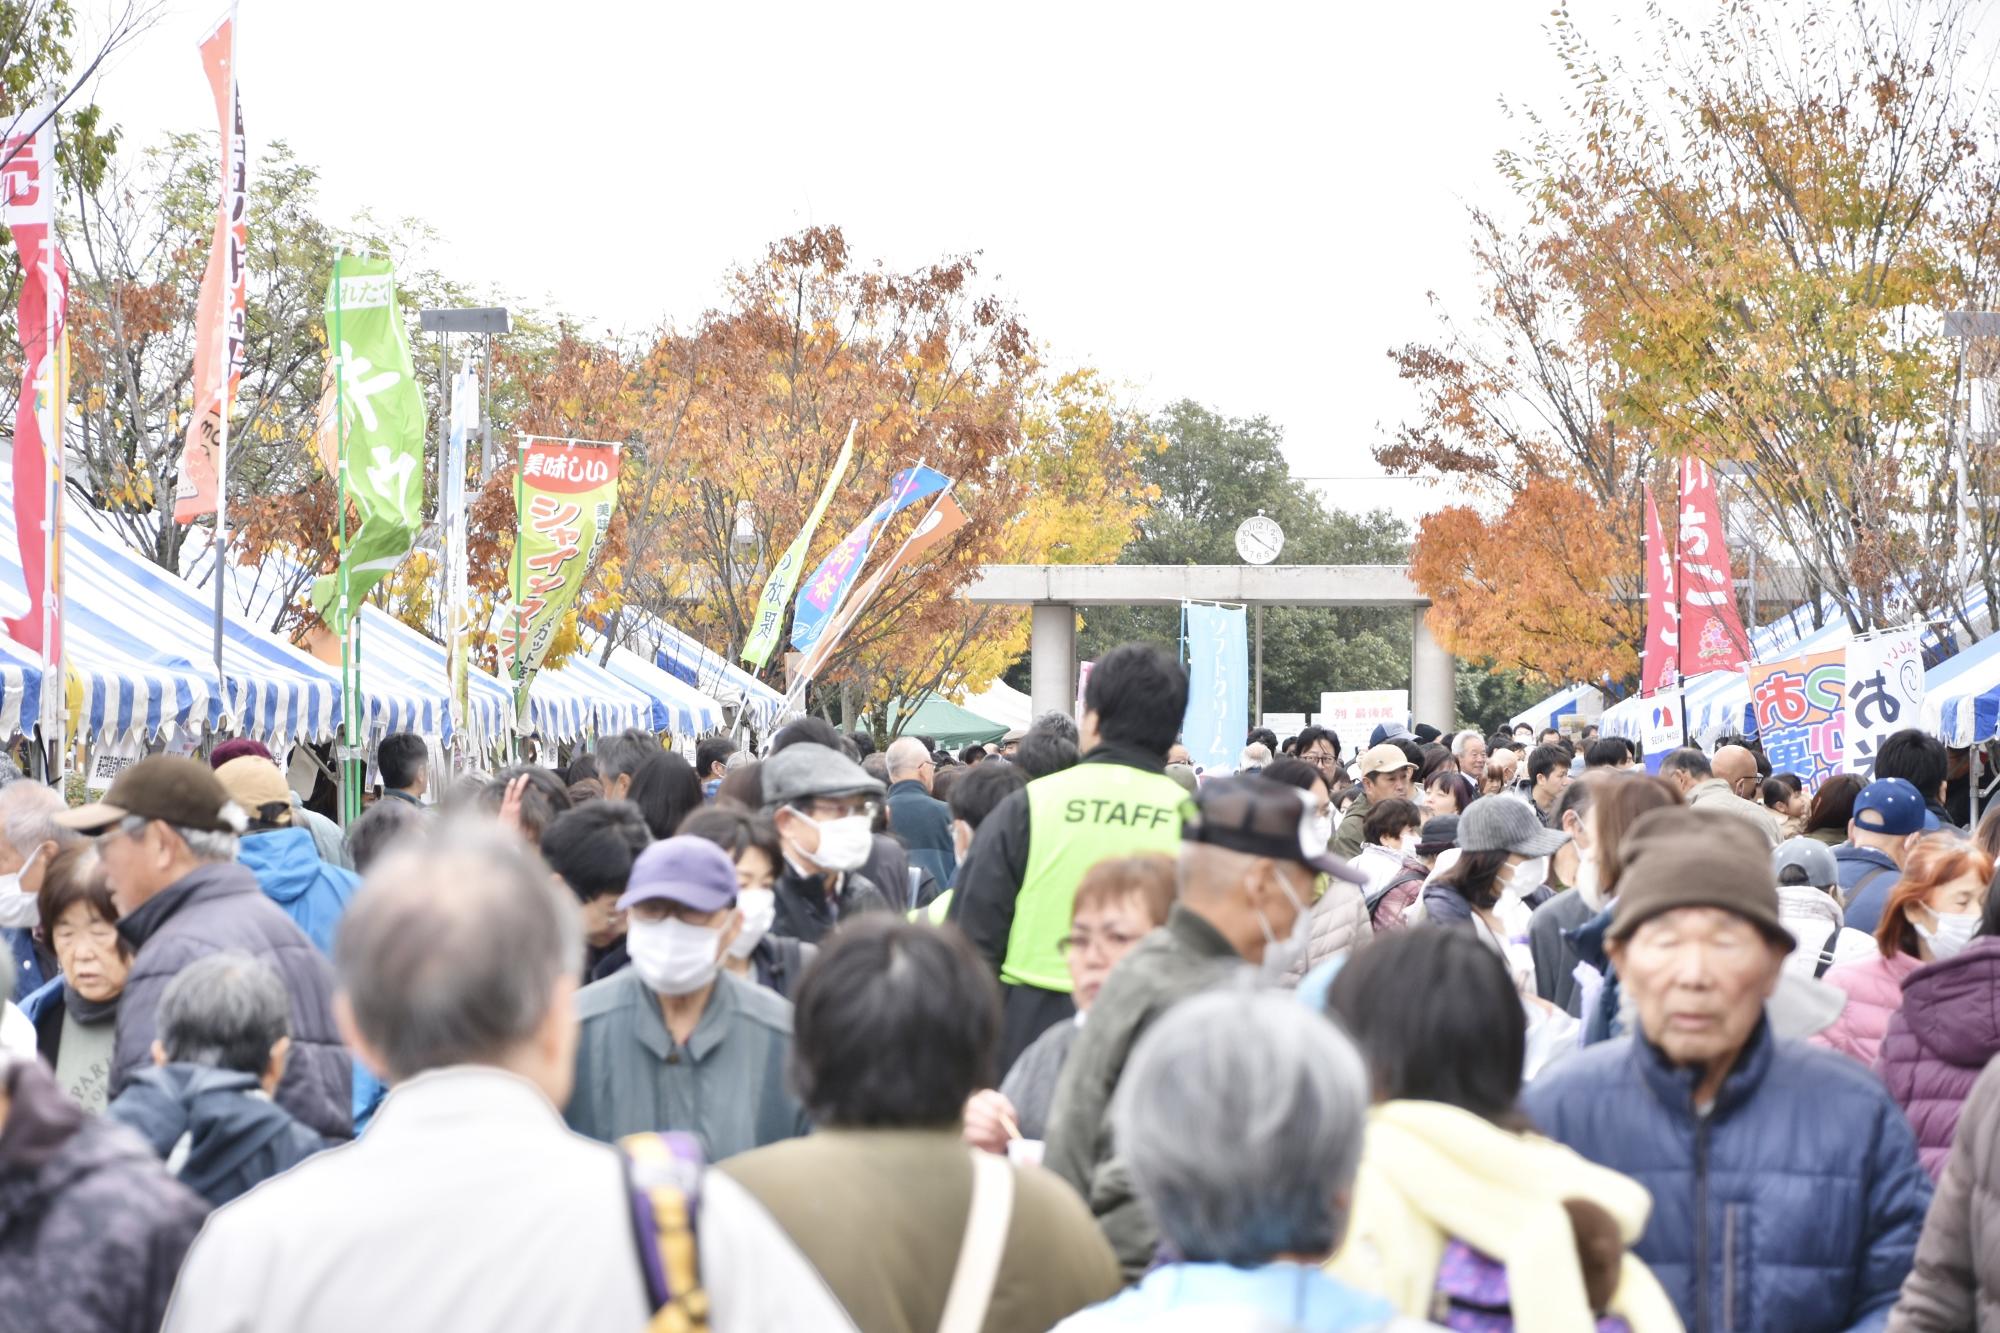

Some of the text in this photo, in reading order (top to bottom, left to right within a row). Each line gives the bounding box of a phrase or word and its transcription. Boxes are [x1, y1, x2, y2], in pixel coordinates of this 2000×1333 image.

[523, 453, 609, 482] 美味しい
[1209, 617, 1228, 756] ソフトクリーム
[1065, 799, 1173, 830] STAFF
